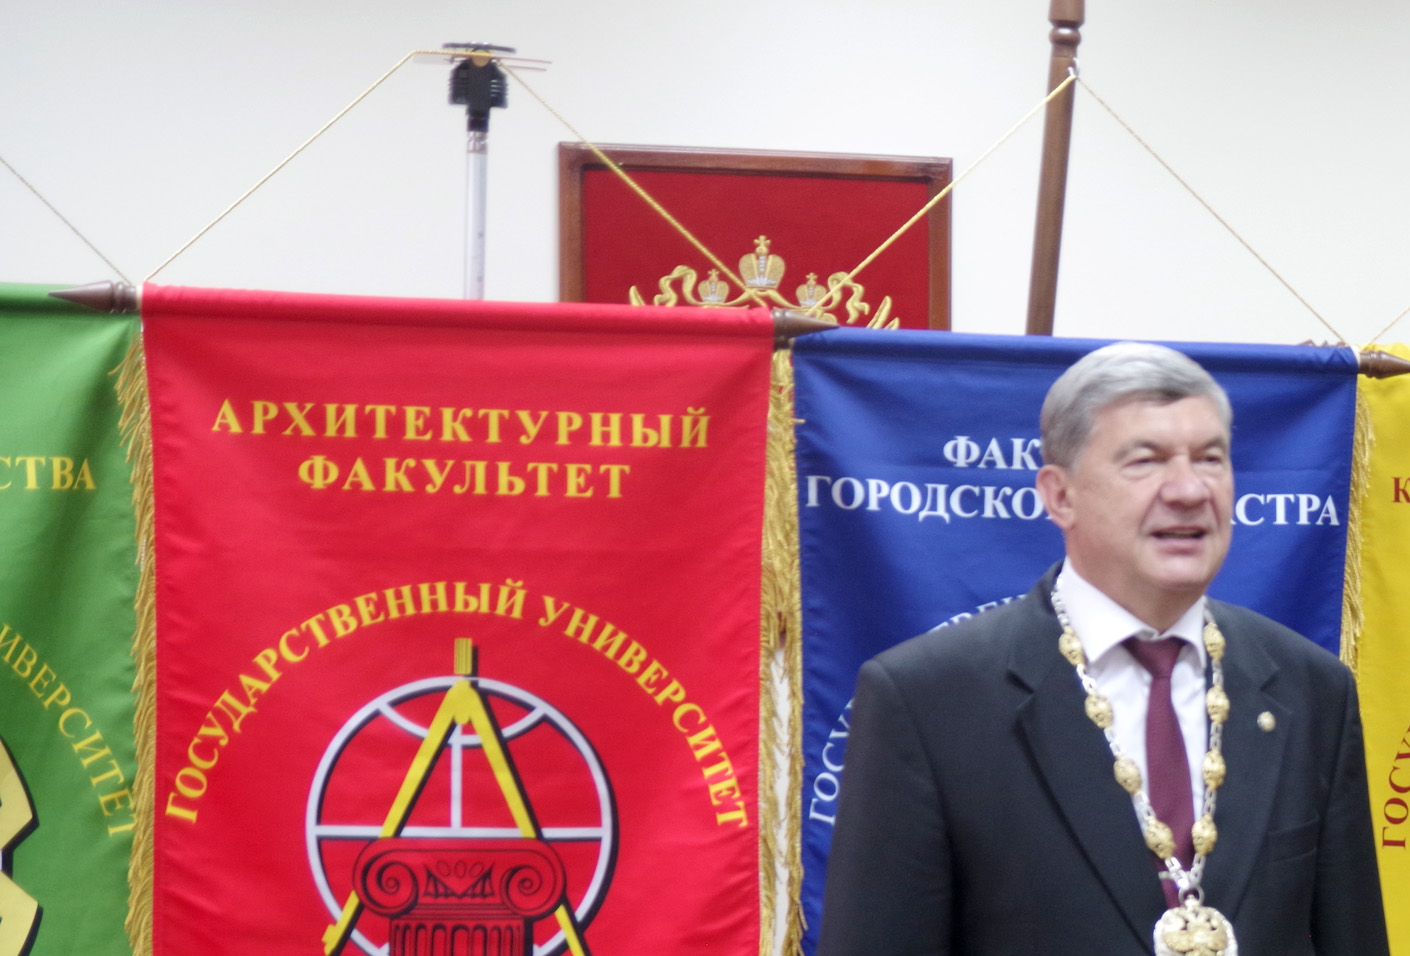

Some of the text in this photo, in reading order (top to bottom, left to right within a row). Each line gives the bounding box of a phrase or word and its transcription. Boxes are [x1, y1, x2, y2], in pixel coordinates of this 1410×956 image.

[211, 398, 712, 450] АРХИТЕКТУРНЫЙ
[298, 455, 631, 500] ФАКУЛЬТЕТ
[805, 475, 1340, 526] ГОРОДСКО СТРА
[164, 578, 529, 825] ГОСУДАРСТВЕННЫЙ
[537, 596, 749, 828] УНИВЕРСИТЕТ
[0, 622, 137, 837] ИВЕРСИТЕТ
